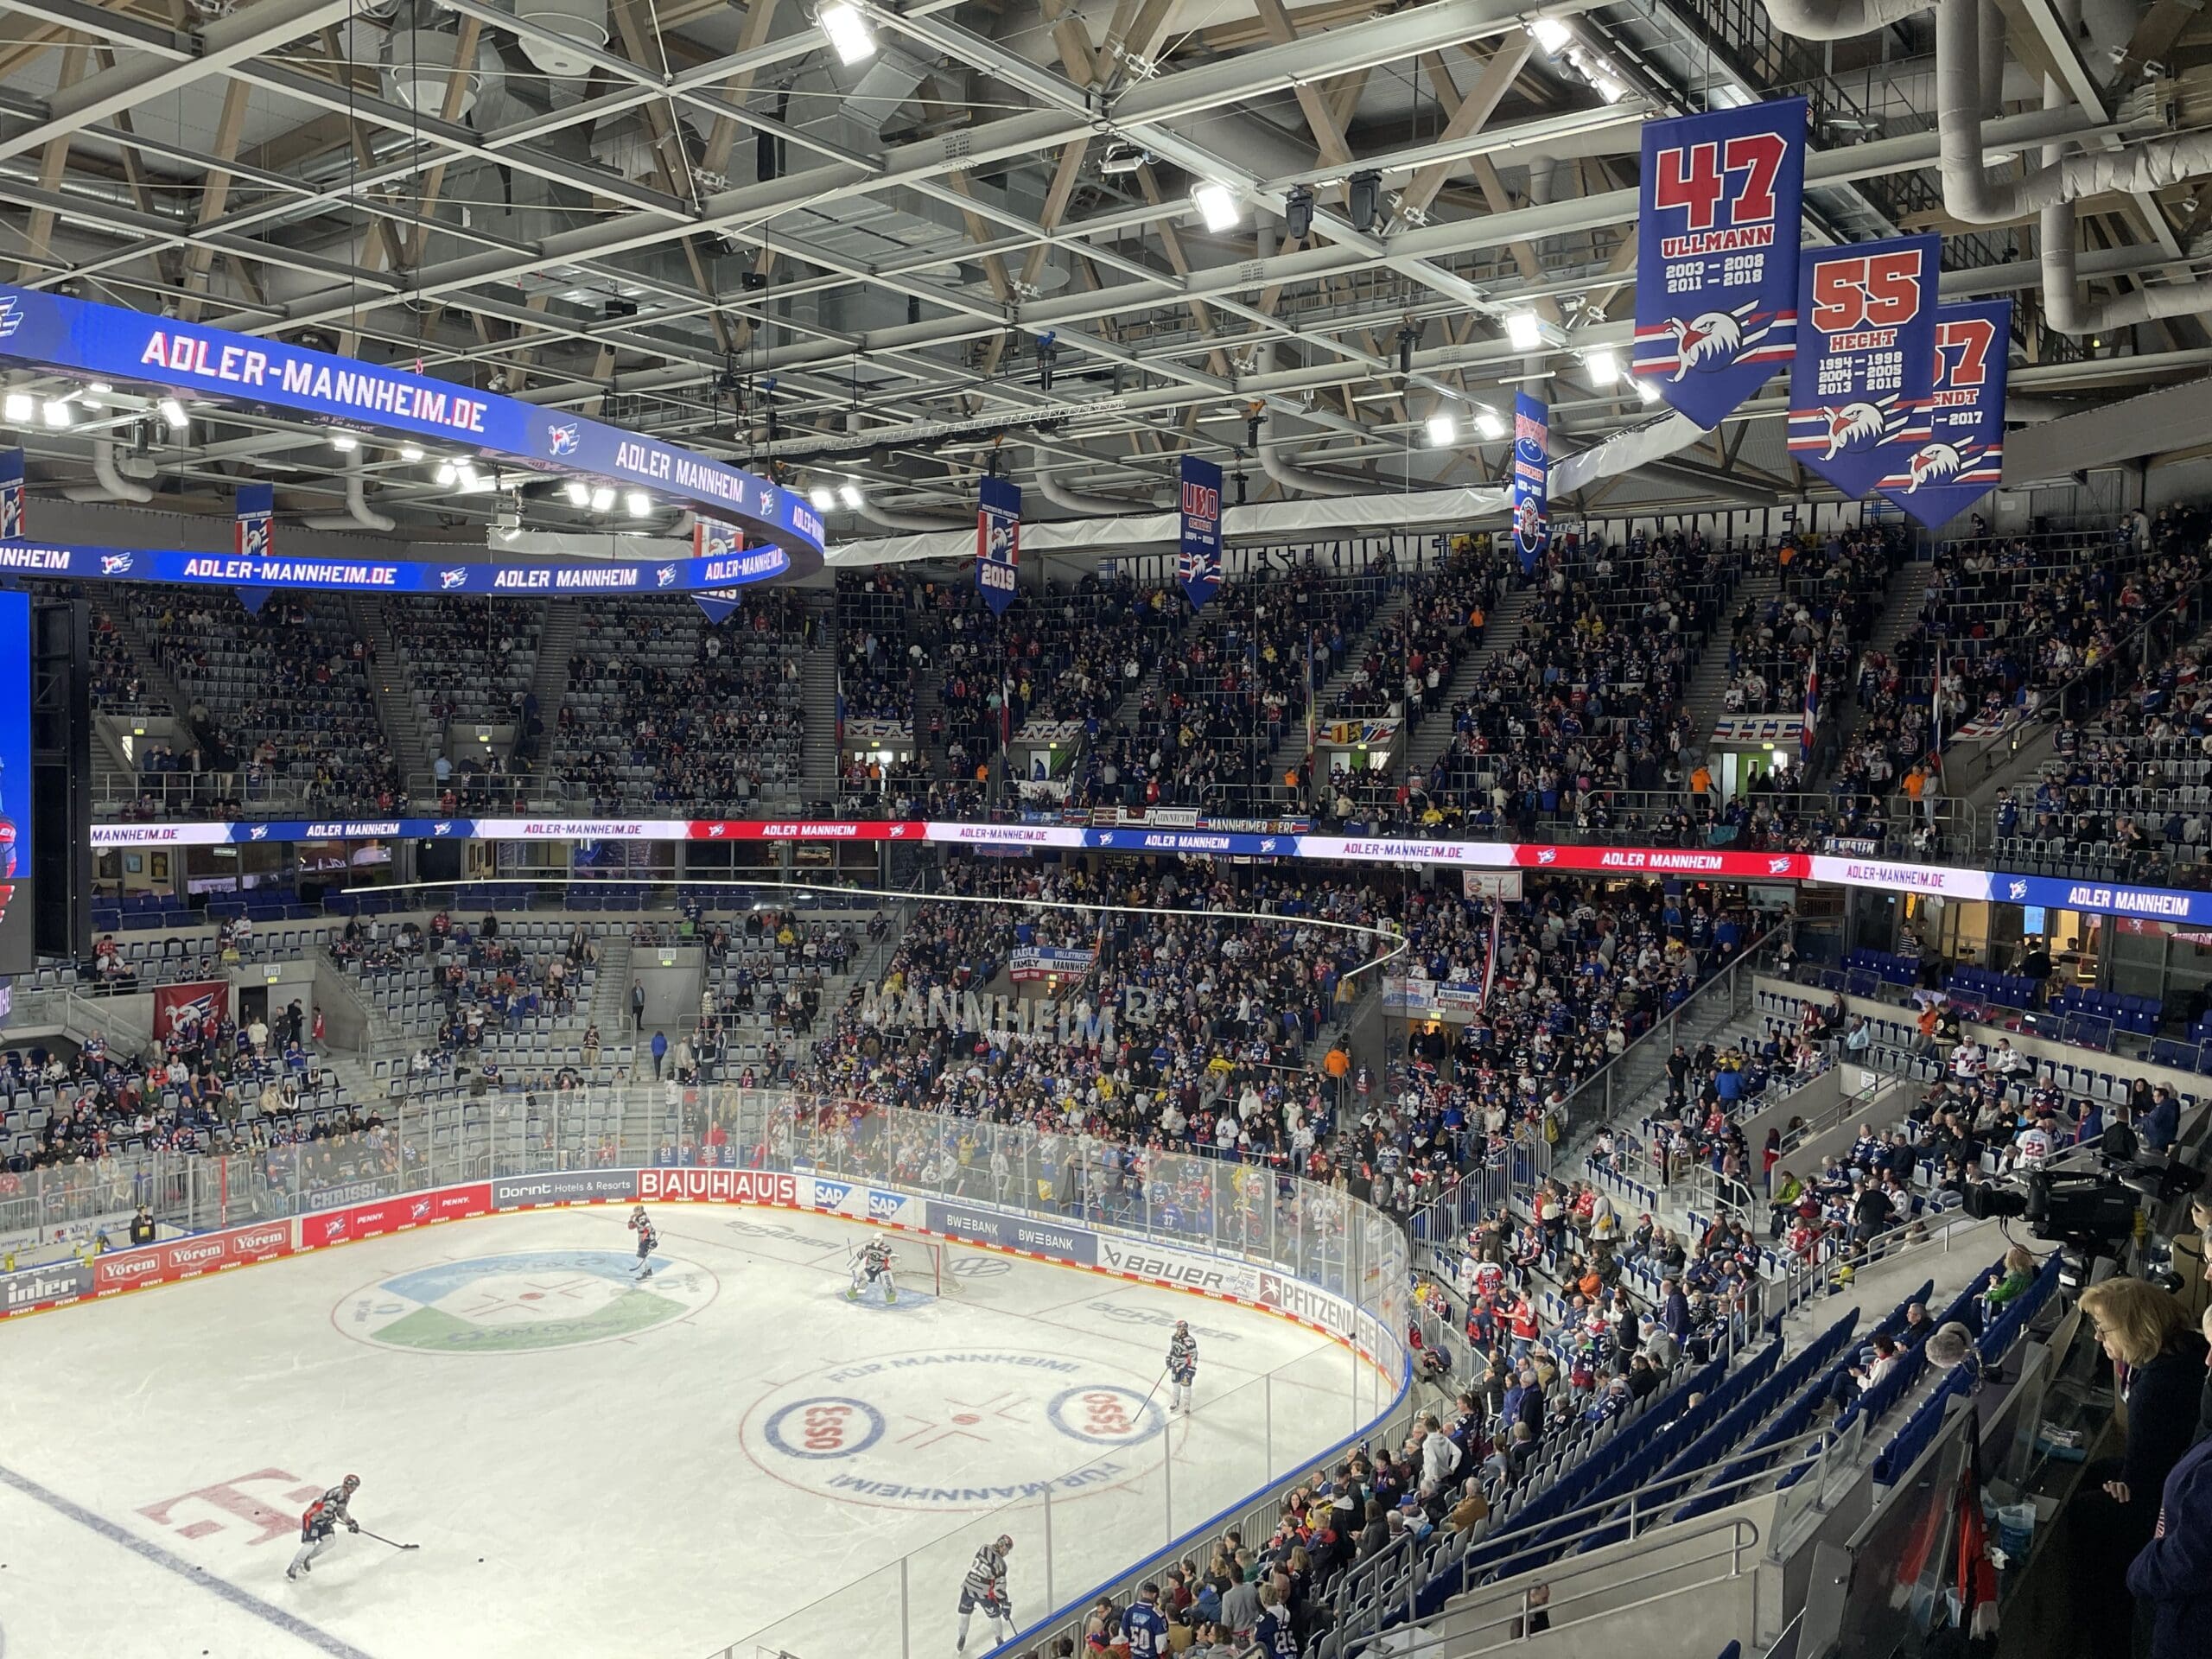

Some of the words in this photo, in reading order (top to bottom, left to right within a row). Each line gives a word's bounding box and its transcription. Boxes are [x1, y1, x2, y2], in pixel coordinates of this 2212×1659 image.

[1655, 131, 1789, 231] 47
[1662, 224, 1774, 259] ULLMANN
[1666, 261, 1704, 279] 2003
[1725, 253, 1764, 271] 2008
[1668, 276, 1702, 293] 2011
[1724, 269, 1763, 286] 2018
[1811, 249, 1923, 333] 55
[1830, 328, 1897, 353] HECHT
[1819, 356, 1853, 372] 1994
[1867, 352, 1903, 367] 1998
[141, 330, 489, 434] ADLER-MANNHEIM.DE
[1819, 368, 1853, 383] 2004
[1867, 365, 1902, 379] 2005
[1818, 380, 1852, 396] 2013
[1866, 377, 1902, 391] 2016
[1932, 388, 1980, 407] ENDT
[1948, 411, 1983, 426] 2017
[615, 441, 671, 480] ADLER
[675, 458, 745, 504] MANNHEIM
[184, 558, 397, 586] ADLER-MANNHEIM.DE
[494, 570, 550, 588] ADLER
[556, 568, 638, 588] MANNHEIM
[982, 563, 1015, 591] 2019
[307, 823, 342, 836] ADLER
[346, 823, 400, 836] MANNHEIM
[524, 824, 642, 835] ADLER-MANNHEIM.DE
[762, 825, 798, 836] ADLER
[801, 825, 857, 836] MANNHEIM
[959, 828, 1047, 842] ADLER-MANNHEIM.DE
[1208, 818, 1268, 834] MANNHEIMER
[1144, 835, 1176, 848] ADLER
[1178, 836, 1230, 849] MANNHEIM
[1343, 842, 1463, 859] ADLER-MANNHEIM.DE
[1601, 852, 1646, 867] ADLER
[1649, 854, 1723, 870] MANNHEIM
[1847, 865, 1945, 888] ADLER-MANNHEIM.DE
[2068, 887, 2112, 907] ADLER
[2114, 890, 2190, 916] MANNHEIM
[2025, 1141, 2044, 1157] 22
[310, 1183, 377, 1209] CHRISSI
[500, 1183, 551, 1198] Dorint
[555, 1181, 584, 1193] Hotels
[587, 1180, 594, 1191] &
[596, 1180, 631, 1191] Resorts
[642, 1173, 794, 1199] BAUHAUS
[816, 1185, 843, 1206] SAP
[869, 1196, 898, 1216] SAP
[238, 1232, 283, 1249] Yörem
[725, 1219, 840, 1250] SCHERER
[173, 1245, 221, 1263] Yörem
[105, 1258, 156, 1277] Yörem
[8, 1277, 77, 1304] inter
[825, 1359, 887, 1382] FÜR
[894, 1353, 1080, 1373] MANNHEIM!
[1083, 1393, 1136, 1435] ESSO
[804, 1406, 851, 1450] ESSO
[1129, 1625, 1150, 1649] 50
